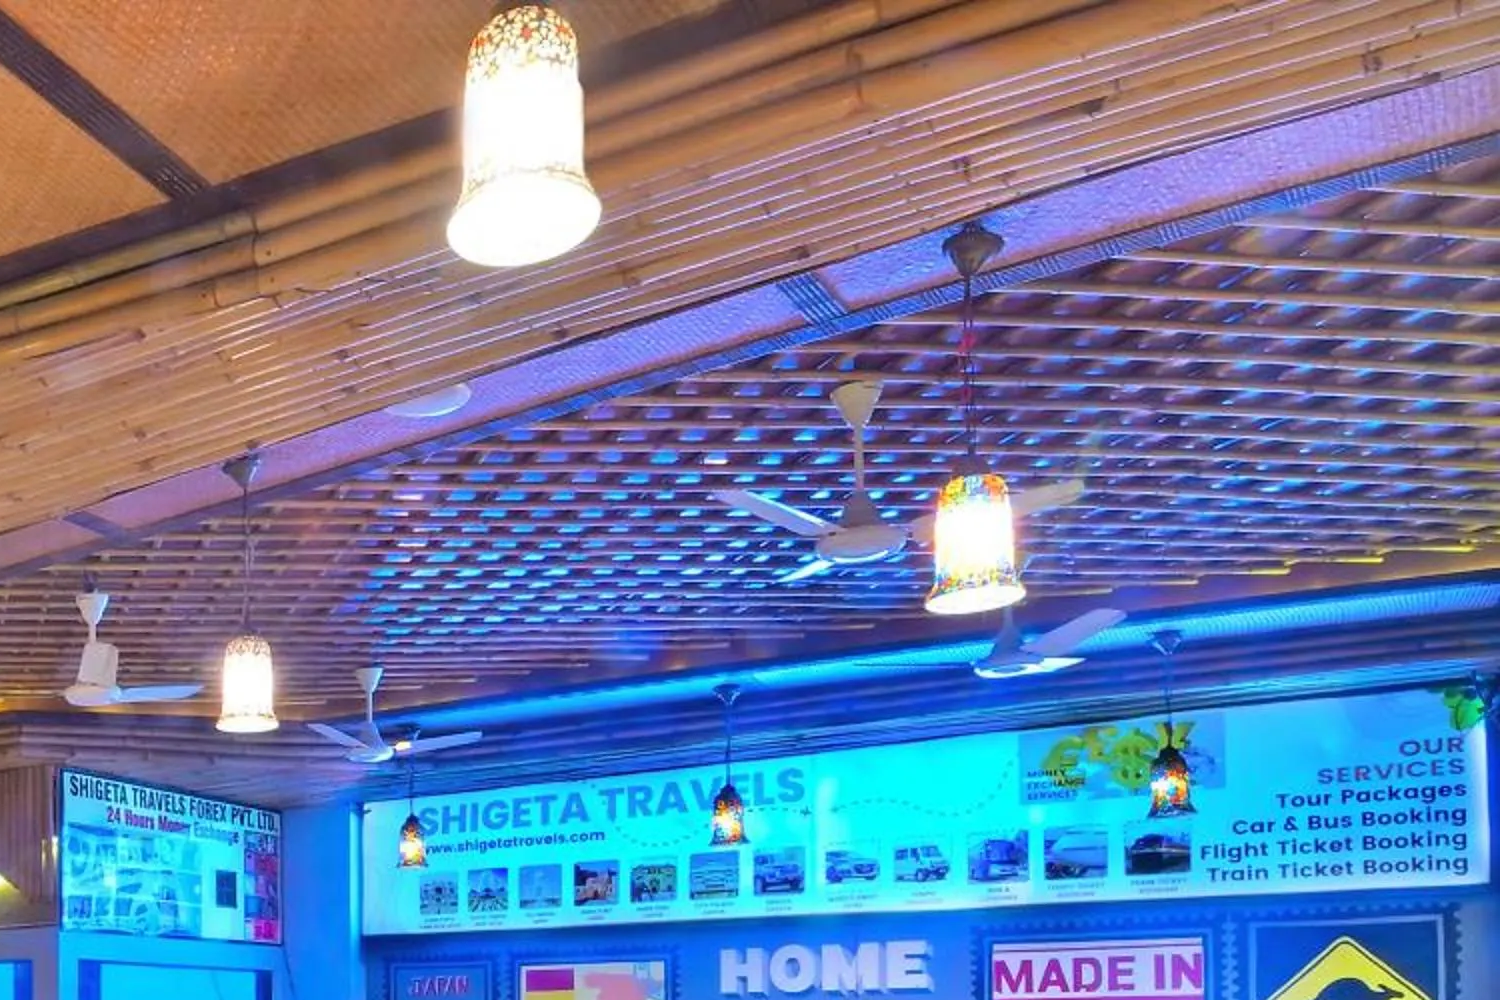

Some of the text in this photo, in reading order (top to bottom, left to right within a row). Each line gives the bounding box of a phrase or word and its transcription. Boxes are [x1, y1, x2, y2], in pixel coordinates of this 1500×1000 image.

[1399, 737, 1464, 756] OUR
[1317, 758, 1465, 784] SERVICES
[70, 775, 128, 805] SHIGETA
[132, 787, 187, 816] TRAVELS
[189, 798, 226, 823] FOREX
[1276, 783, 1467, 809] Tour Packages
[107, 805, 121, 824] 24
[419, 792, 591, 836] SHIGETA
[1232, 806, 1467, 834] Car & Bus Booking
[1201, 830, 1467, 863] Flight Ticket Booking
[1207, 854, 1469, 882] Train Ticket Booking
[720, 940, 933, 995] HOME
[994, 952, 1203, 994] MADE IN
[408, 975, 469, 996] JAPAN
